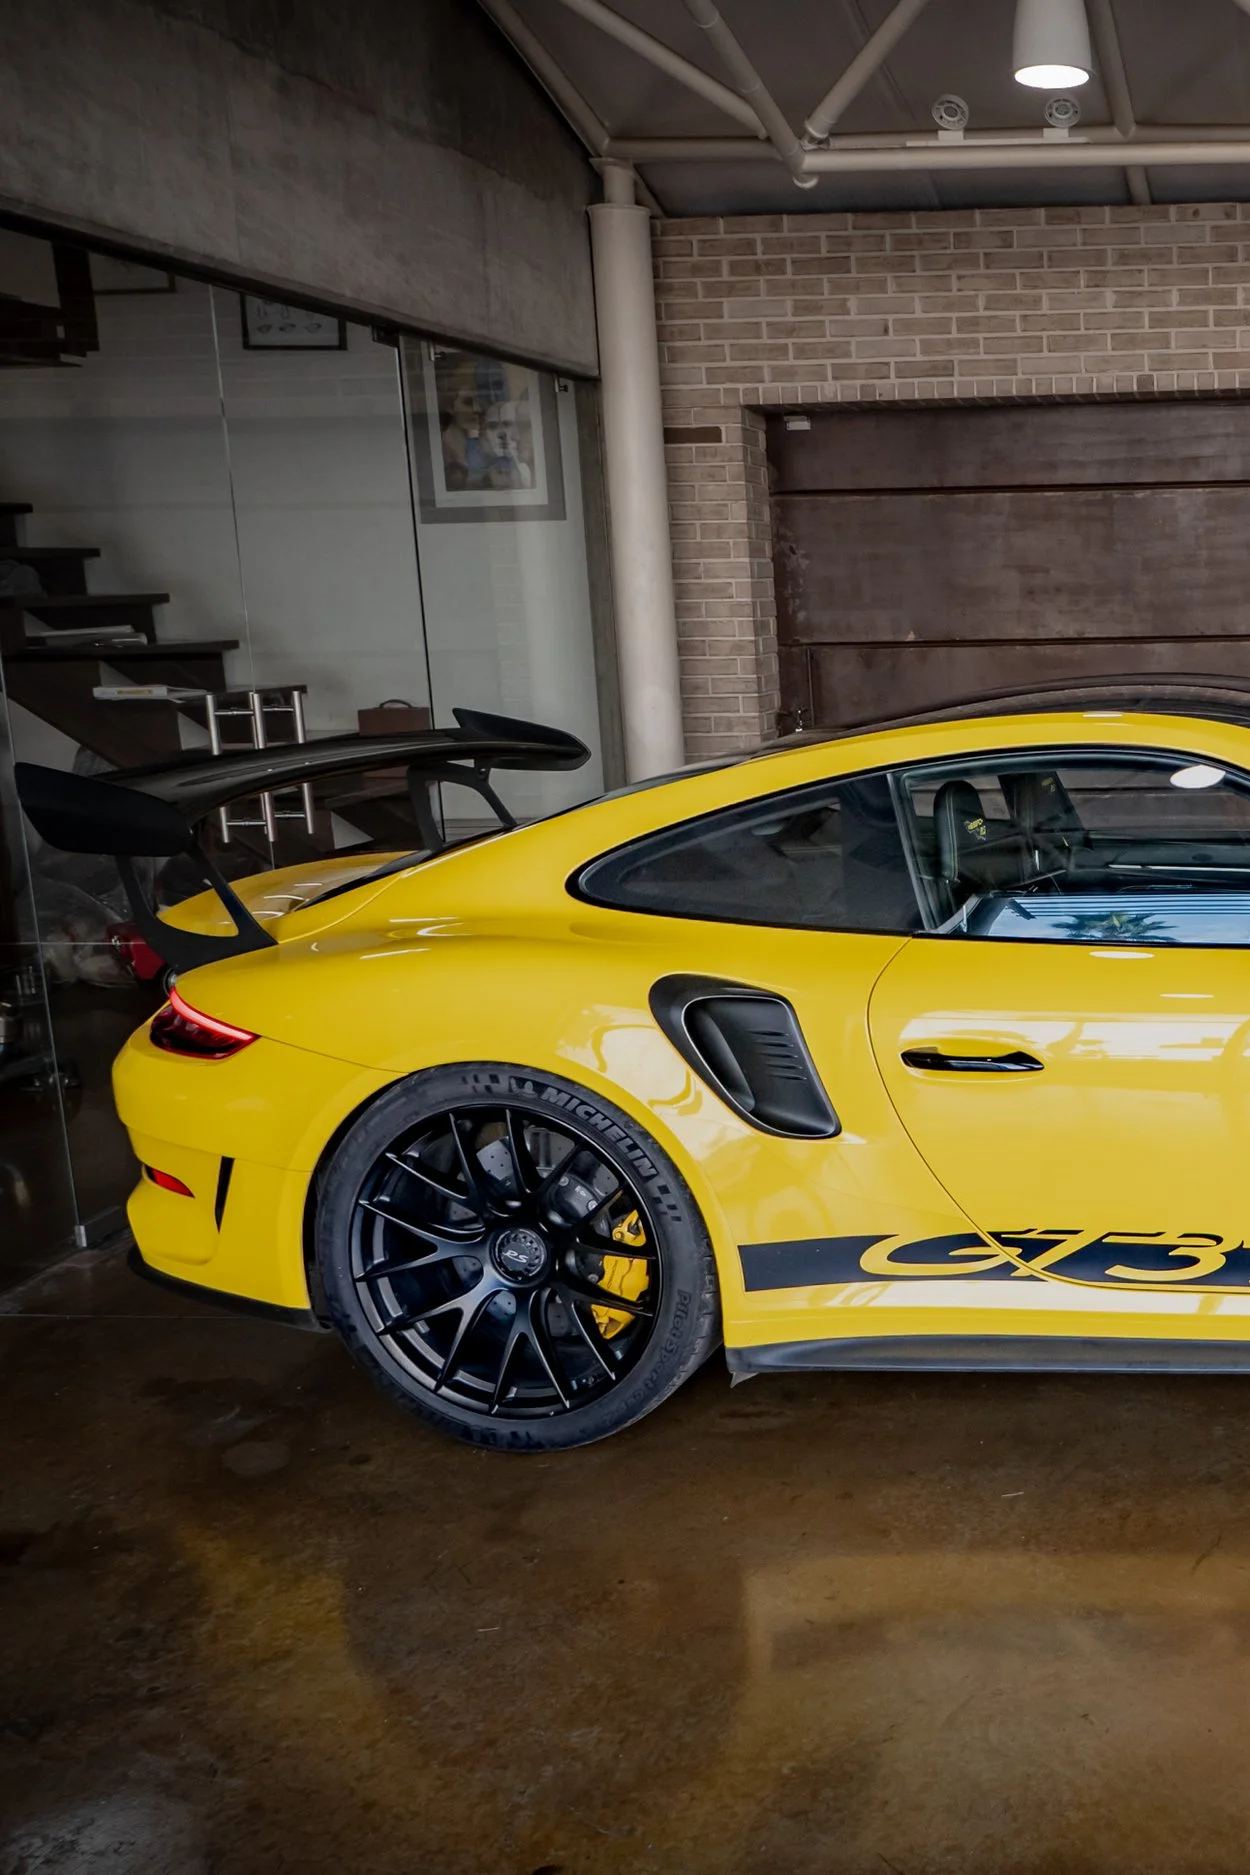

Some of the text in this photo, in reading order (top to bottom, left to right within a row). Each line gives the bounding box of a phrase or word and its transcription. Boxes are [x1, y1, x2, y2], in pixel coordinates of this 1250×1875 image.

[541, 1087, 659, 1177] MICHELIN
[502, 1249, 529, 1263] RS
[860, 1229, 1242, 1281] GT3
[670, 1289, 691, 1339] Pilot
